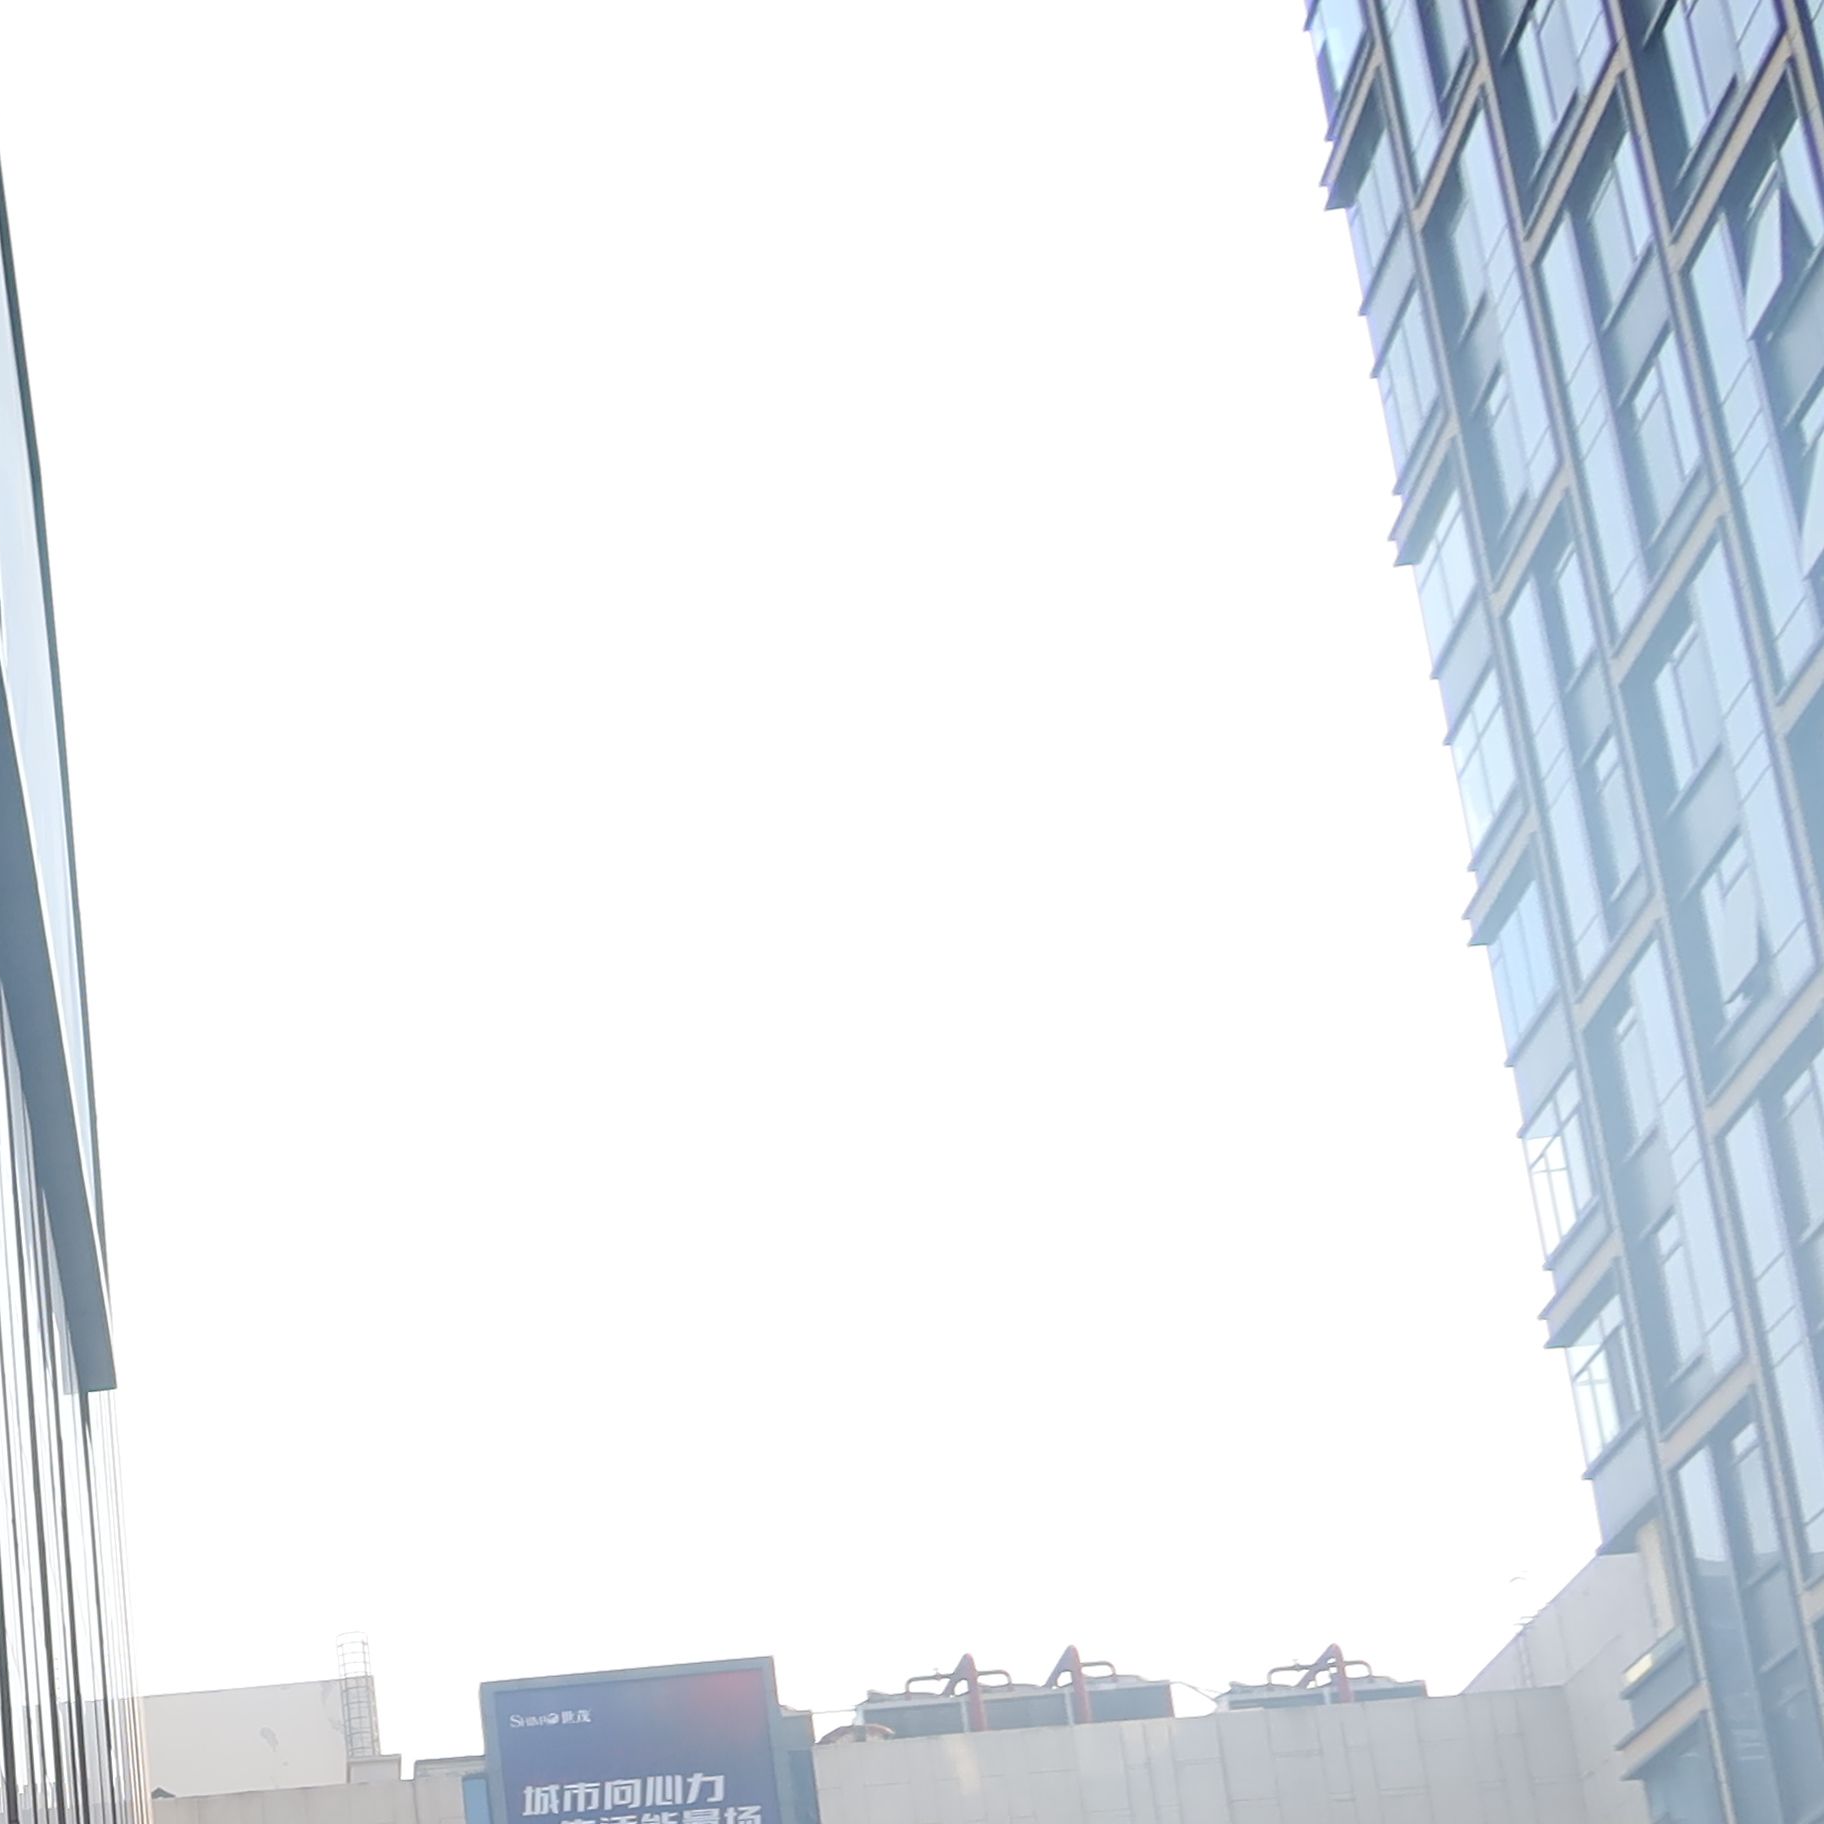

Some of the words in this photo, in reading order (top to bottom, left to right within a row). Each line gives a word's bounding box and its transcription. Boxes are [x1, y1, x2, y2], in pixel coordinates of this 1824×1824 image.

[522, 1772, 726, 1817] 城市向心力
